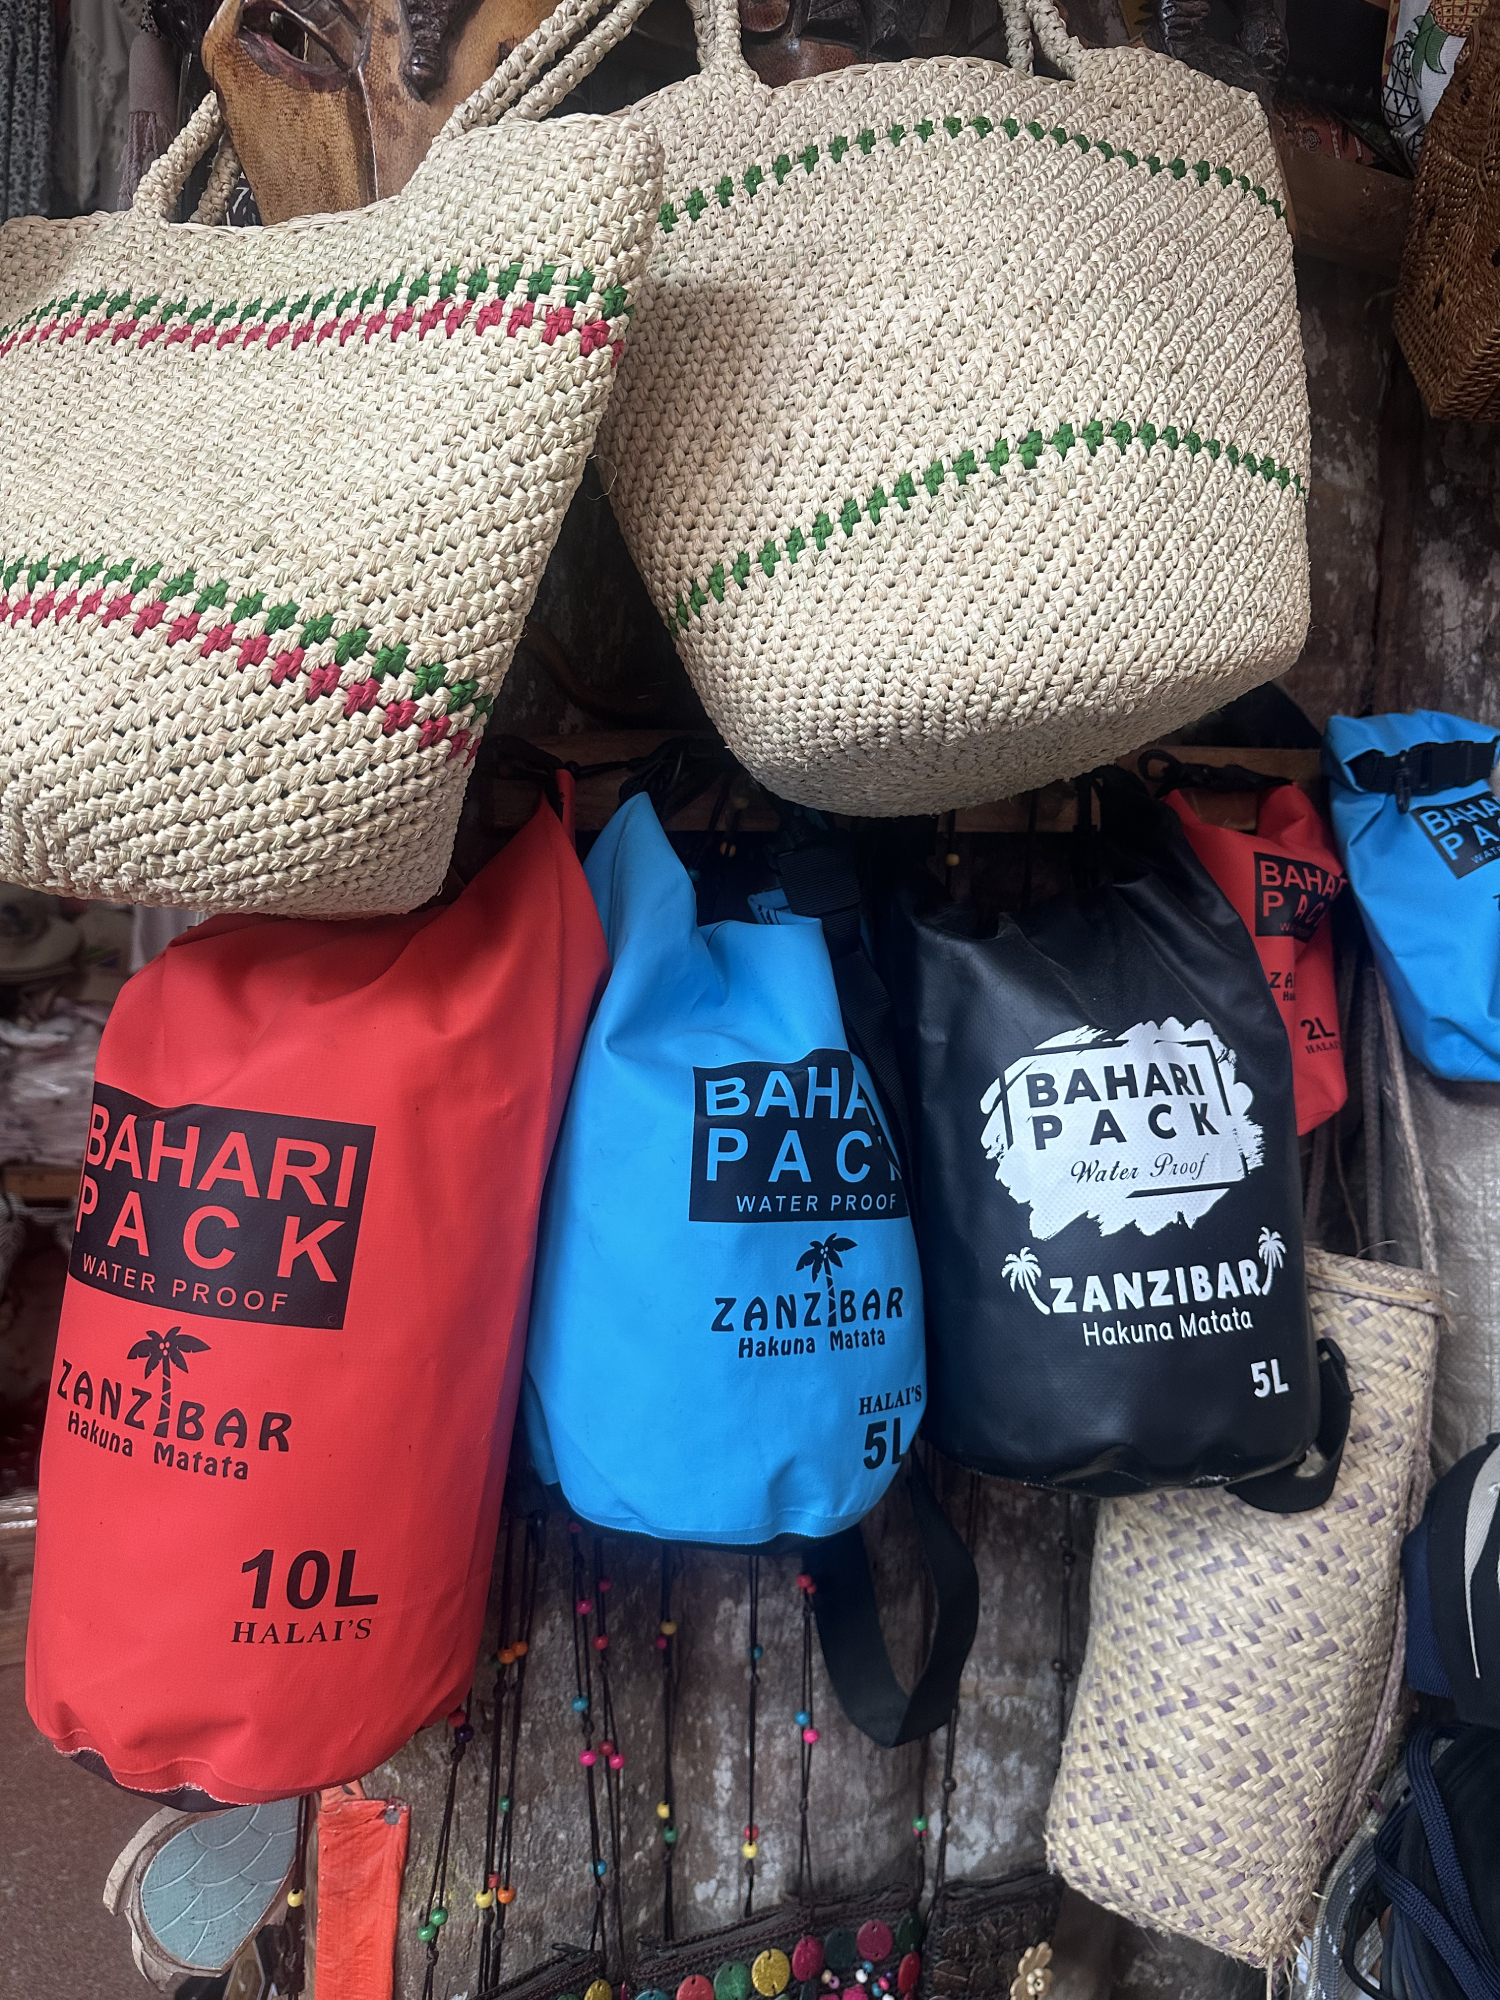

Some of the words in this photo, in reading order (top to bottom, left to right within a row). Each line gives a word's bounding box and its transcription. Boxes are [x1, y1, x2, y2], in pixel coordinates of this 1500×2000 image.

[1439, 817, 1500, 861] PA
[1262, 891, 1327, 927] PAC
[1300, 1017, 1336, 1040] 2L
[1025, 1062, 1205, 1108] BAHARI
[1032, 1103, 1219, 1151] PACK
[86, 1103, 358, 1208] BAHARI
[706, 1127, 902, 1184] PAC
[1070, 1160, 1139, 1184] Water
[1150, 1152, 1209, 1179] Proof
[736, 1195, 819, 1213] WATER
[830, 1193, 897, 1211] PROOF
[76, 1174, 346, 1283] PACK
[82, 1253, 156, 1293] WATER
[172, 1279, 288, 1312] PROOF
[1049, 1258, 1265, 1314] ZANZIBAR
[711, 1287, 904, 1332] ZANZIBAR
[1082, 1320, 1174, 1347] Hakuna
[1179, 1307, 1254, 1338] Matata
[738, 1336, 816, 1358] Hakuna
[830, 1328, 886, 1351] Matata
[858, 1384, 922, 1416] HALAI'S
[1250, 1358, 1289, 1398] 5L
[57, 1359, 292, 1452] ZANZIBAR
[67, 1410, 133, 1458] Hakuna
[153, 1441, 249, 1480] Matata
[241, 1549, 379, 1609] 10L
[231, 1618, 372, 1644] HALAI'S
